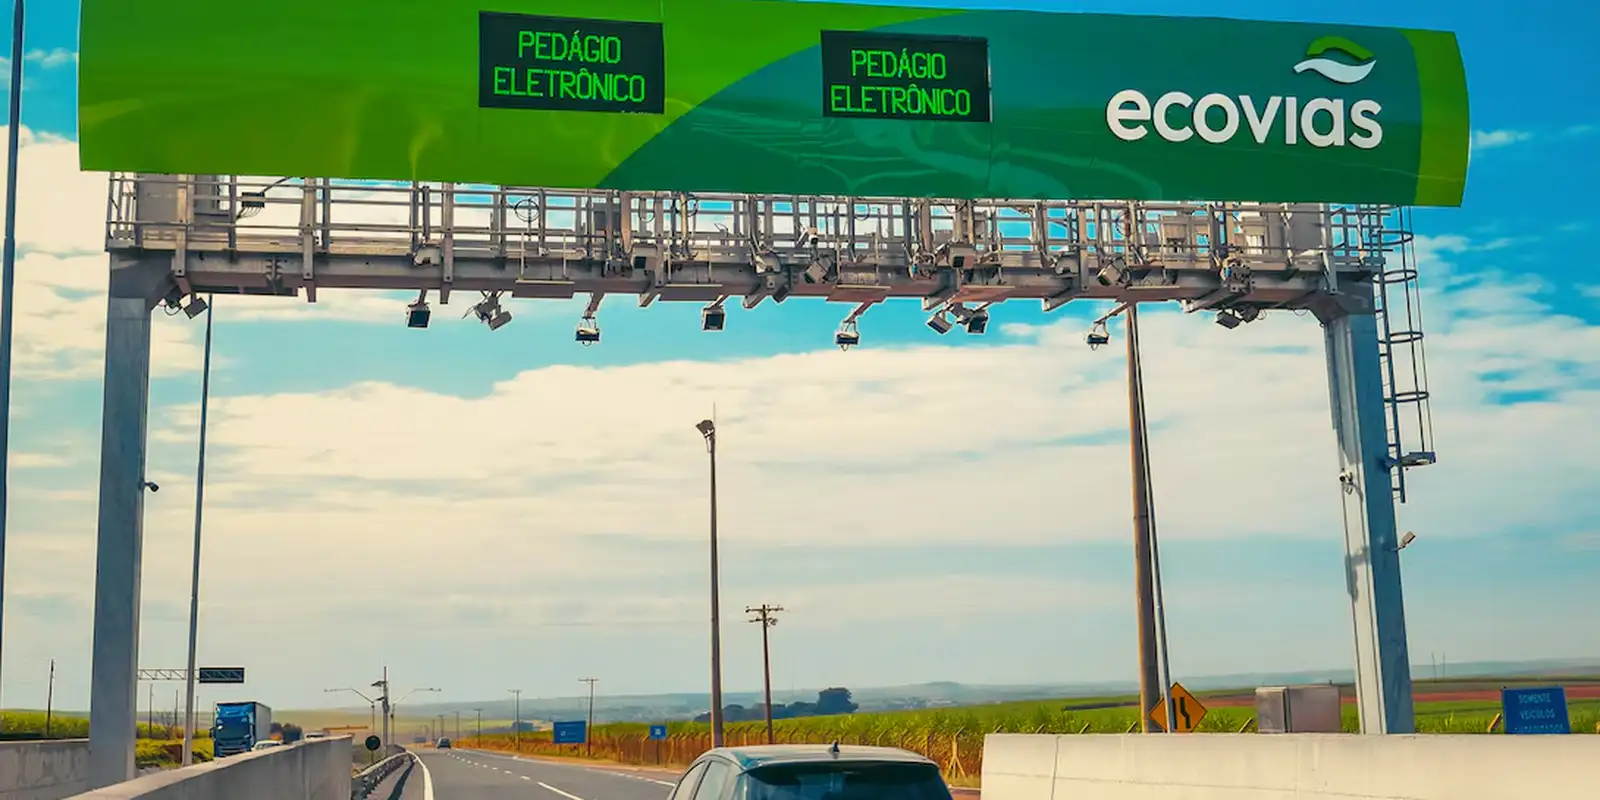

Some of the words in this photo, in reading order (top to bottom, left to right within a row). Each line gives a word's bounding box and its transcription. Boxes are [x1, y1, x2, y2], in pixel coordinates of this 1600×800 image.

[518, 29, 621, 64] PEDÁGIO
[850, 47, 947, 80] PEDÁGIO
[493, 65, 646, 103] ELETRÔNICO
[830, 83, 971, 117] ELETRÔNICO
[1106, 88, 1383, 149] ecovias
[1518, 692, 1552, 704] SOMENTE
